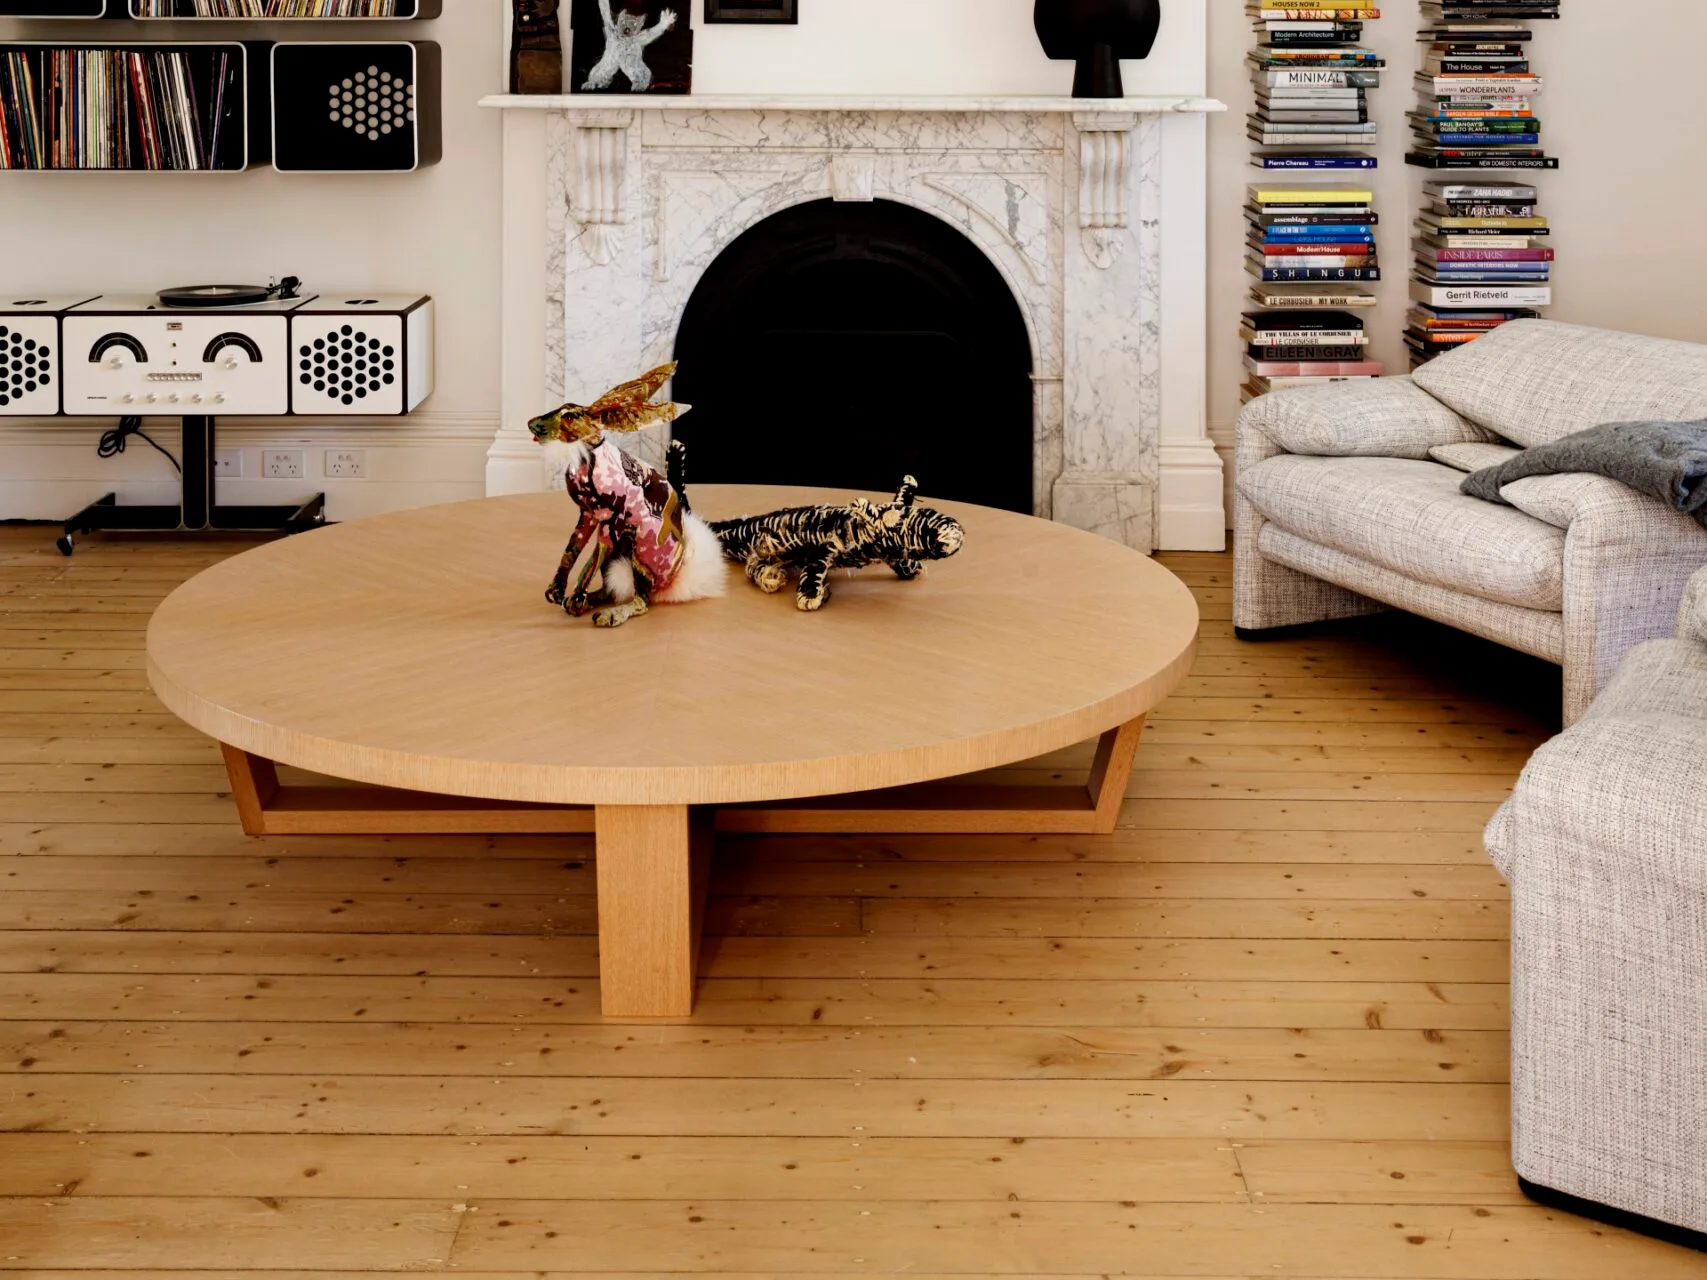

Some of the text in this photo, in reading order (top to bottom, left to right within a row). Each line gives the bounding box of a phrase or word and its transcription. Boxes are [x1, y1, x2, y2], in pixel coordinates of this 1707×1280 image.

[1446, 63, 1459, 71] The
[1461, 63, 1482, 71] House
[1289, 72, 1343, 83] MINIMAL
[1444, 251, 1503, 259] INSIDE PARIS
[1272, 269, 1361, 277] SHINGU
[1446, 291, 1508, 299] Gerrit Rietveld
[1266, 346, 1360, 358] EILEEN GRAY
